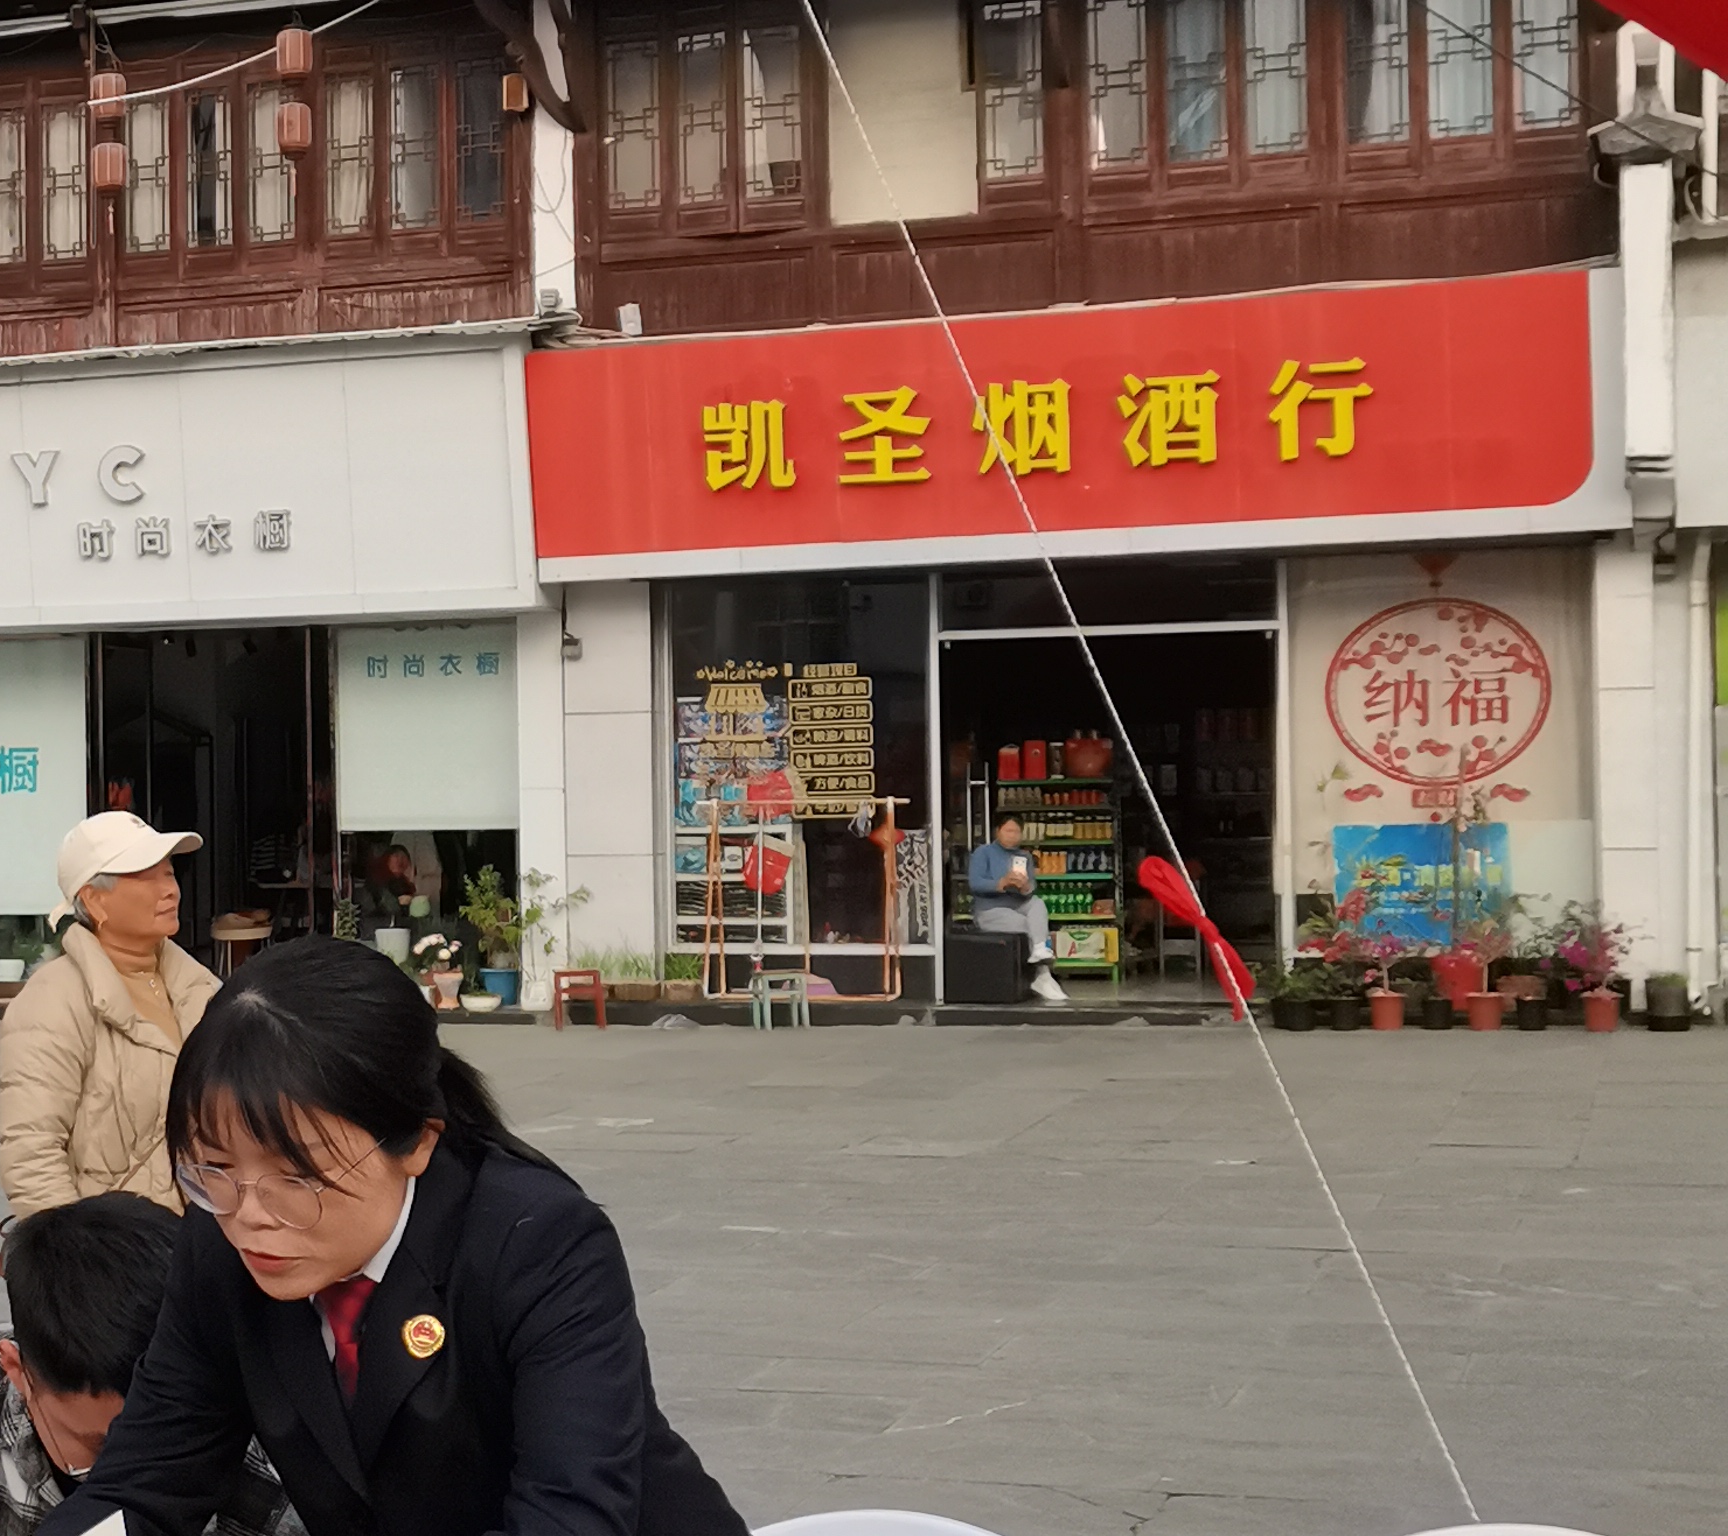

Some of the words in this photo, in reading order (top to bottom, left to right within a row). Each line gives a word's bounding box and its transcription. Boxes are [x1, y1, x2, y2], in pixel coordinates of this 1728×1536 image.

[702, 356, 1375, 491] 凯圣烟酒行
[76, 508, 293, 561] 时尚衣橱
[366, 651, 501, 680] 时尚衣橱
[1363, 667, 1513, 728] 纳福
